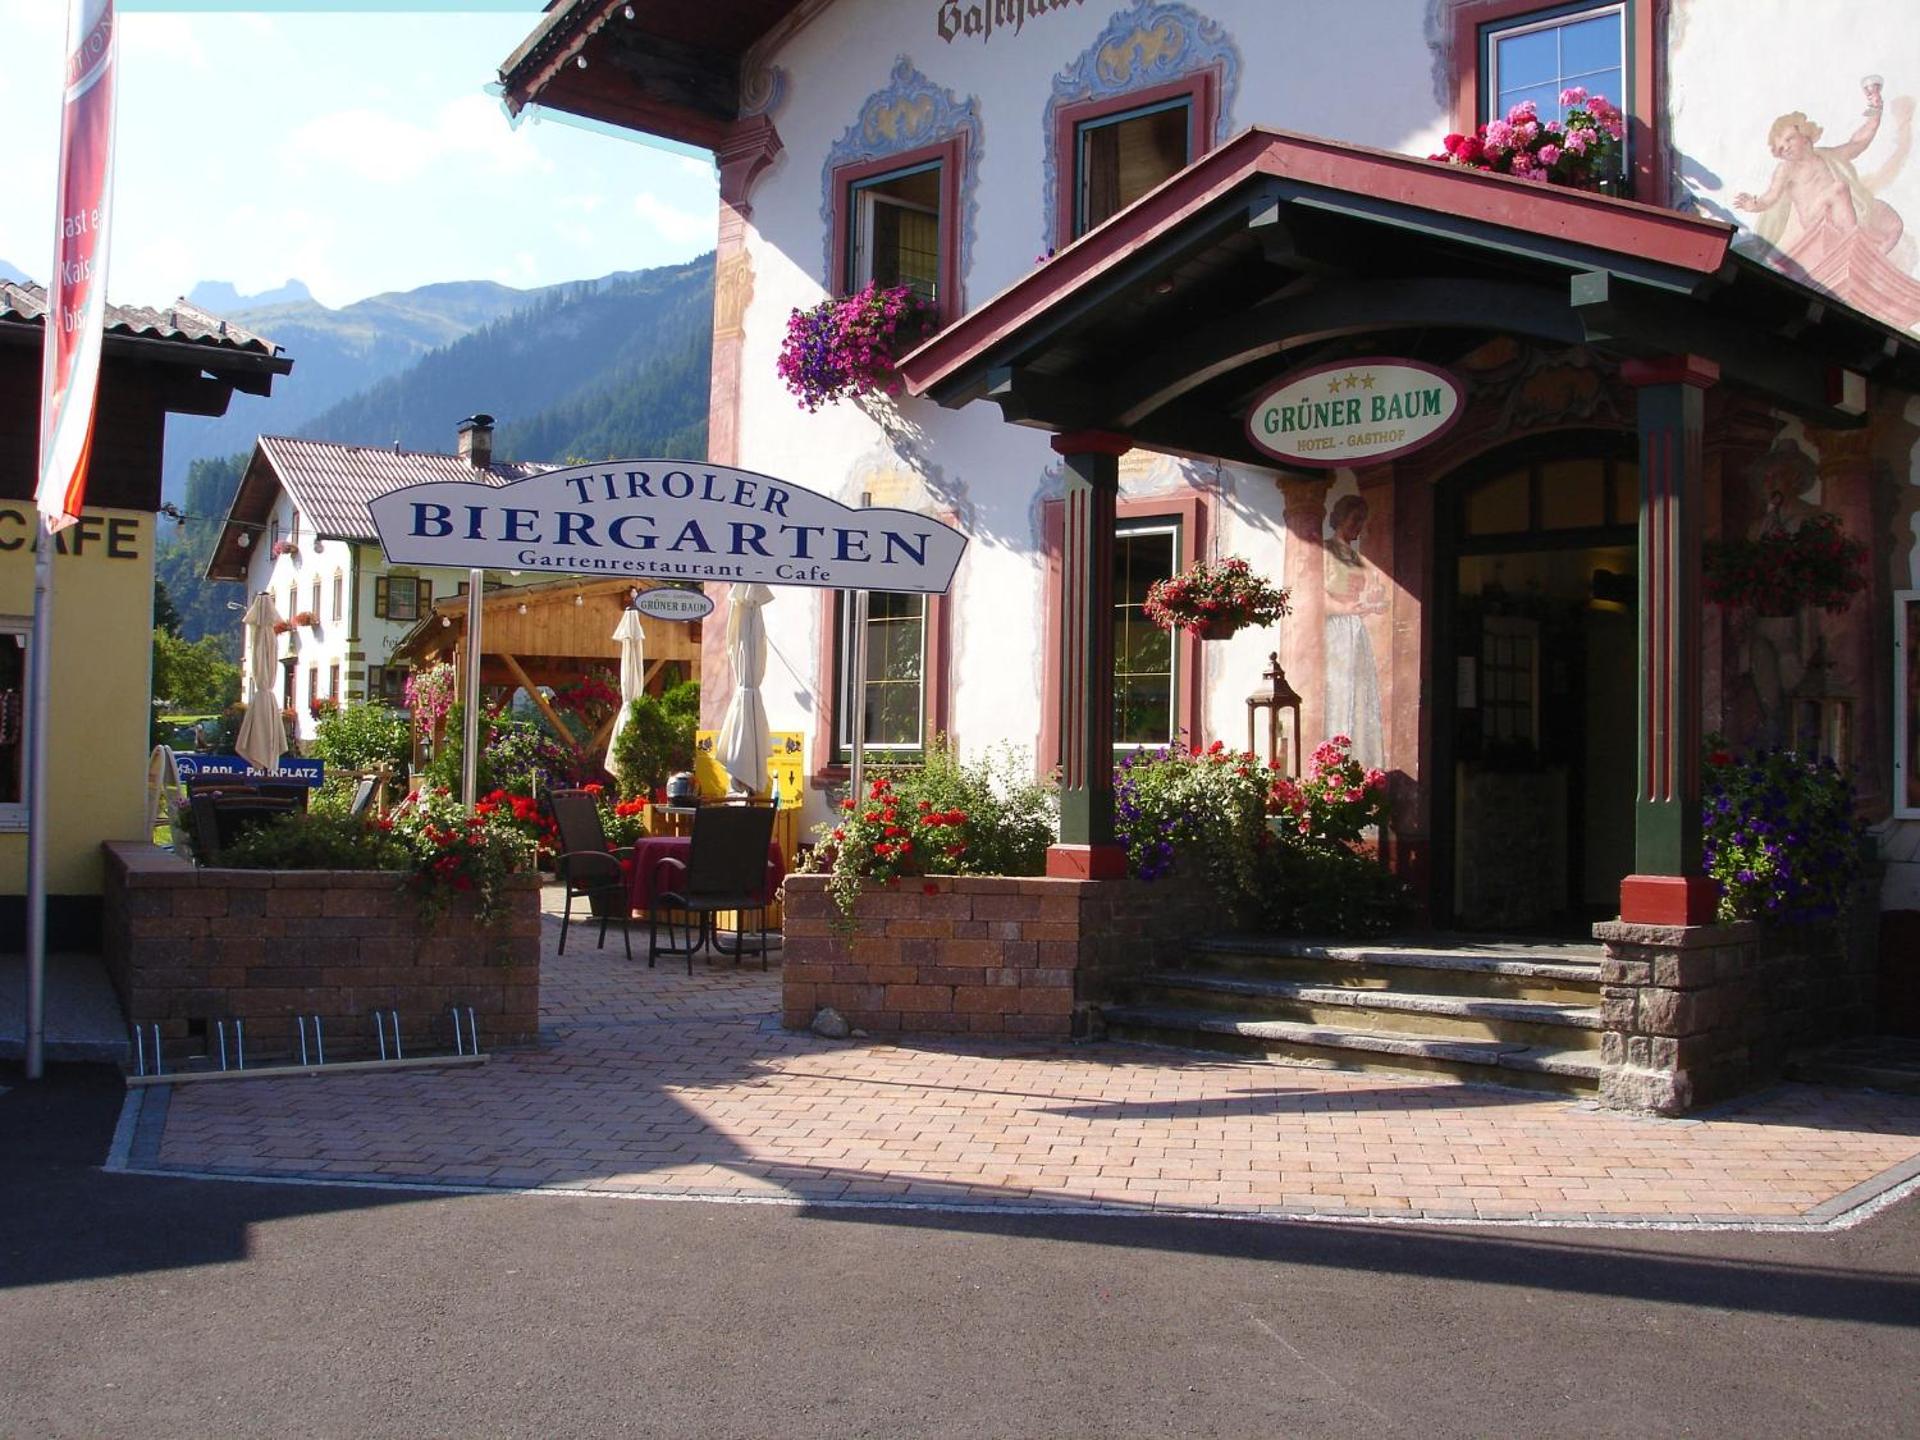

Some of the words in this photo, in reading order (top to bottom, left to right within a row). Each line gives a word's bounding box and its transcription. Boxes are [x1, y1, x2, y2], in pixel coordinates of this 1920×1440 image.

[938, 0, 1084, 44] Gastha
[1264, 397, 1361, 434] GRÜNER
[1371, 388, 1442, 423] BAUM
[1297, 436, 1336, 452] HOTEL
[1347, 429, 1406, 447] GASTHOF
[566, 471, 790, 518] TIROLER
[408, 502, 932, 566] BIERGARTEN
[518, 550, 744, 577] Gartenrestaurant
[776, 564, 831, 582] Cafe
[640, 598, 678, 611] GRÜNER
[681, 602, 706, 613] BAUM
